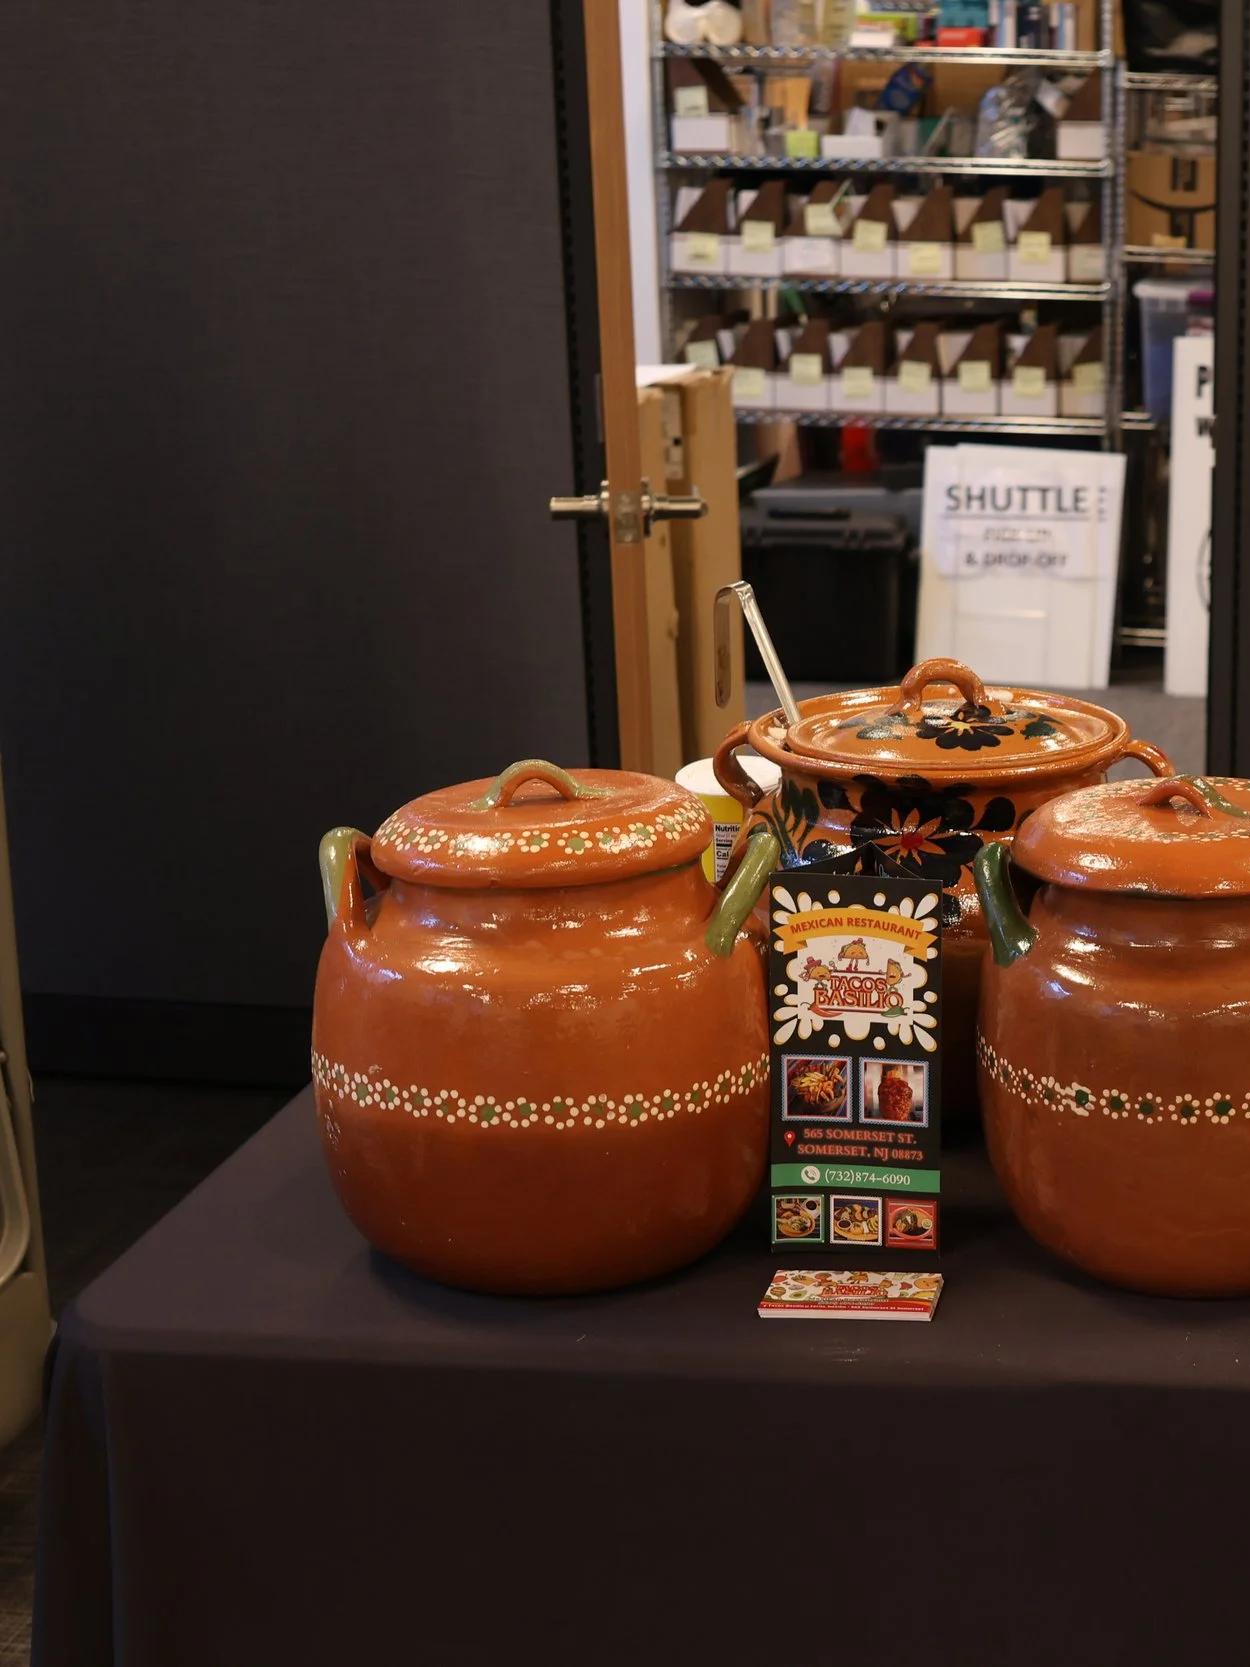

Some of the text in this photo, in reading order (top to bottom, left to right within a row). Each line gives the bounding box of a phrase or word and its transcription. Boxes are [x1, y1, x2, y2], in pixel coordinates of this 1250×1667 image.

[944, 484, 1088, 514] SHUTTLE
[715, 824, 741, 832] Nutriti
[790, 917, 922, 940] MEXICAN RESTAURANT
[829, 975, 888, 993] TACOS
[813, 987, 904, 1009] BASILIO
[803, 1128, 917, 1144] 565 SOMERSET ST.
[797, 1143, 924, 1161] SOMERSET, NJ 08873
[824, 1168, 911, 1186] (732)874-6090
